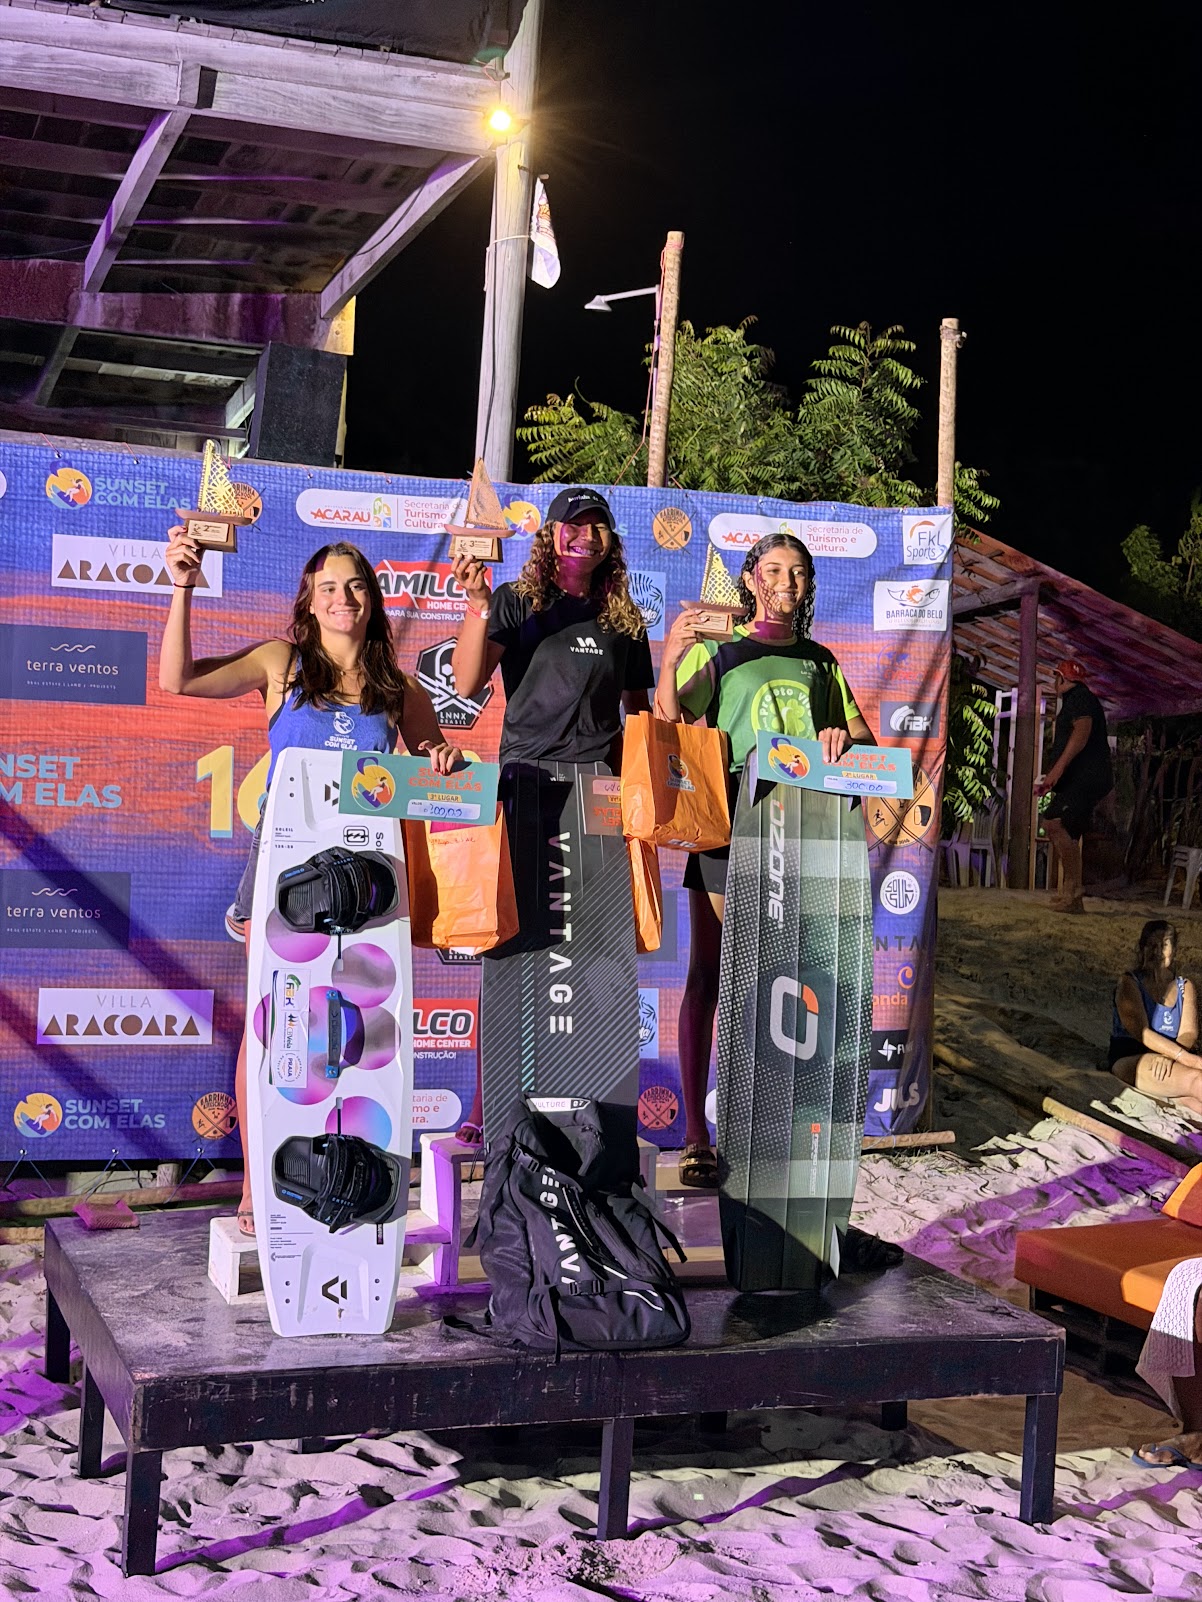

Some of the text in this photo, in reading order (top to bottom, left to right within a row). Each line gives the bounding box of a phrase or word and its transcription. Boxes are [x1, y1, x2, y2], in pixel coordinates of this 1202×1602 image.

[95, 478, 168, 495] SUNSET
[95, 492, 191, 510] COM ELAS
[404, 499, 450, 511] Secretaria
[311, 508, 371, 523] ACARAU
[404, 508, 448, 519] Turismo
[404, 518, 446, 529] Cultura
[807, 524, 864, 535] Secretaria de
[722, 532, 761, 544] ACAR
[807, 534, 857, 544] Turismo e
[109, 544, 163, 560] VILLA
[57, 559, 210, 589] ARACOAA
[377, 571, 467, 600] AMILC
[427, 601, 453, 610] HOME
[421, 612, 465, 622] CONSTRUÇÃ
[27, 659, 120, 675] terra ventos
[440, 711, 467, 720] LNNX
[0, 753, 80, 780] NSET
[859, 761, 897, 772] ELAS
[852, 772, 874, 780] LUGAR
[408, 777, 482, 792] COM ELAS
[35, 783, 123, 809] ELAS
[438, 794, 459, 802] LUGAR
[375, 832, 384, 851] Sol
[7, 905, 101, 919] terra ventos
[548, 831, 573, 1035] VANTAGE
[97, 995, 152, 1008] VILLA
[42, 1014, 200, 1036] ARACOARA
[413, 1011, 473, 1036] LCO
[437, 1039, 471, 1048] CENTER
[413, 1050, 457, 1060] NSTRUÇÃO!
[65, 1099, 143, 1113] SUNSET
[65, 1114, 166, 1129] COM ELAS
